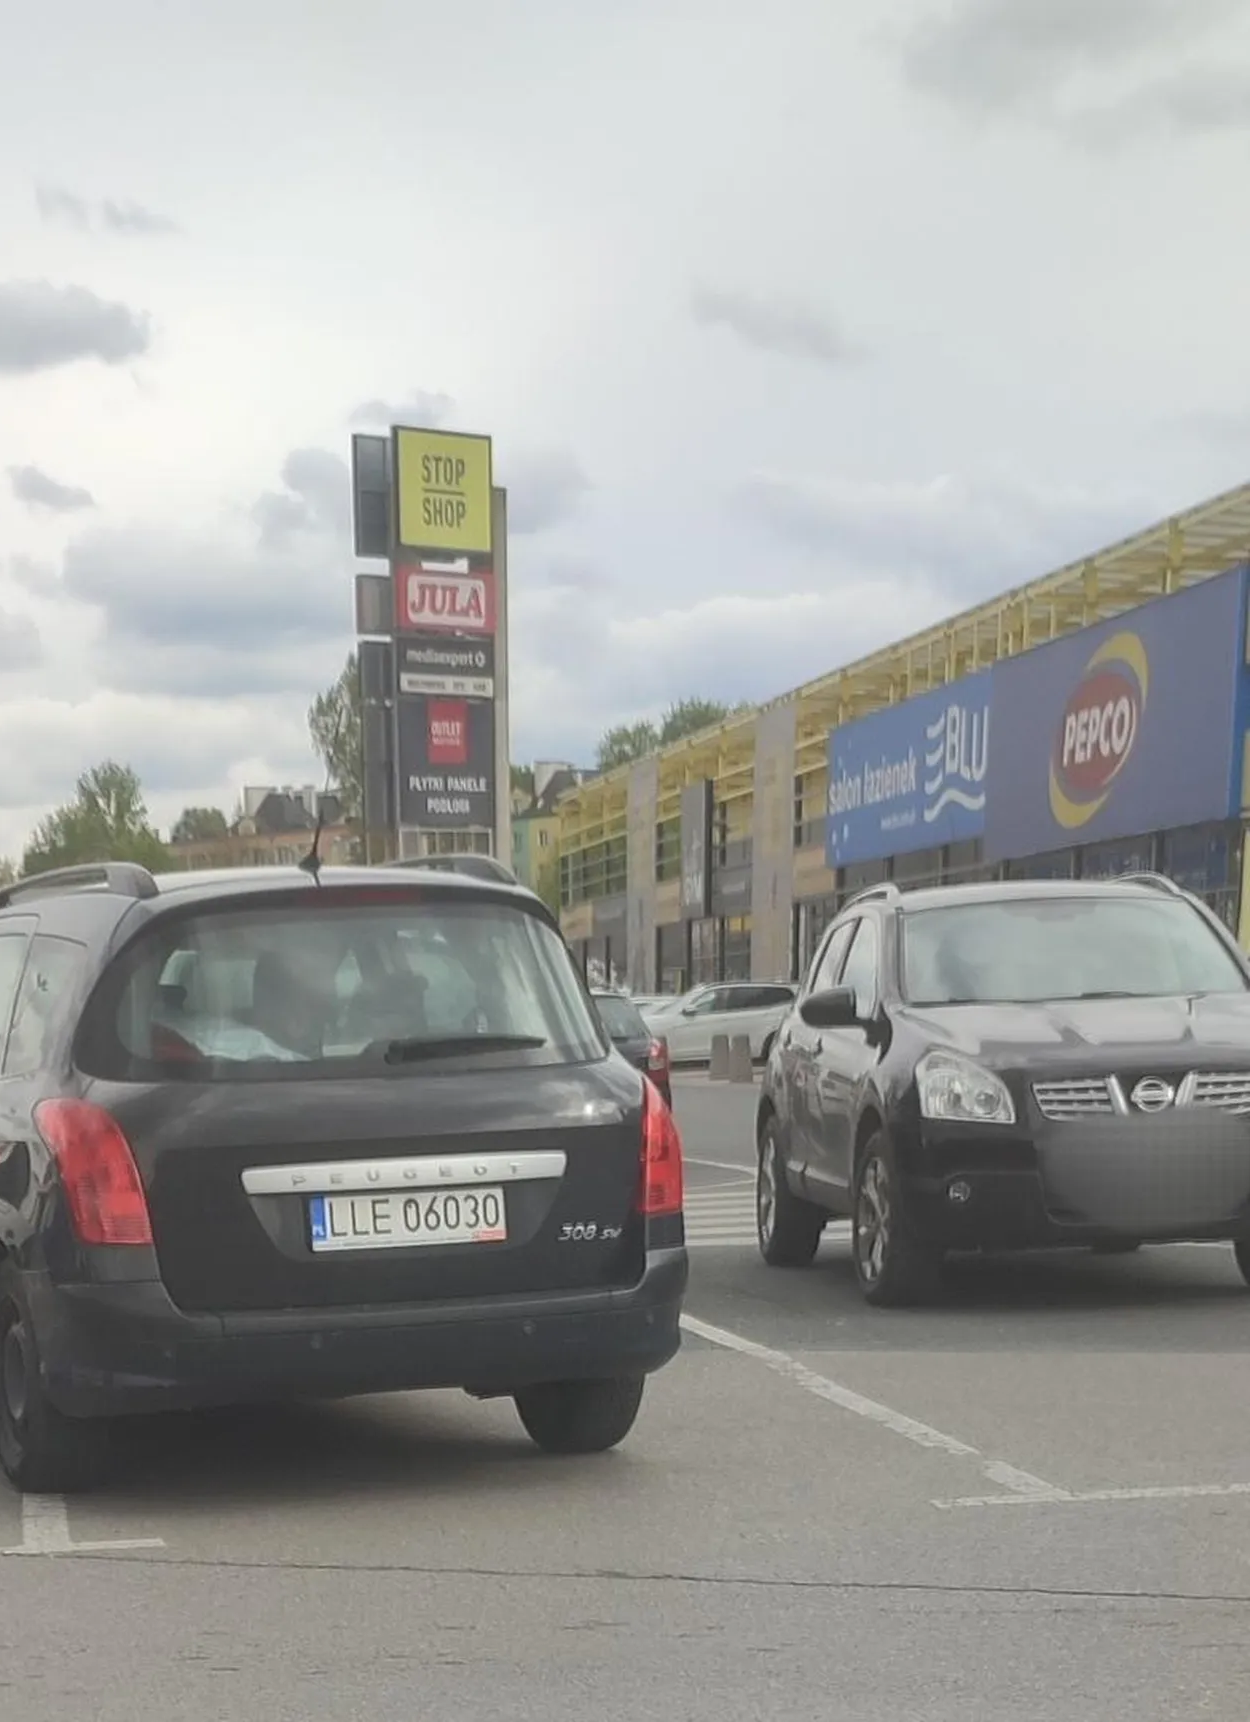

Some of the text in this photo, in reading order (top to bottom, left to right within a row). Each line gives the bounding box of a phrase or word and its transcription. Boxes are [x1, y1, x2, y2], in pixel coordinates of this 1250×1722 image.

[421, 454, 465, 486] STOP
[421, 497, 466, 528] SHOP
[410, 583, 483, 619] JULA
[945, 704, 989, 782] BLU
[1062, 695, 1130, 768] PEPCO
[829, 768, 862, 816] salon
[291, 1161, 523, 1187] PEUGEOT
[329, 1193, 501, 1237] LLE 06030
[558, 1222, 597, 1241] 308
